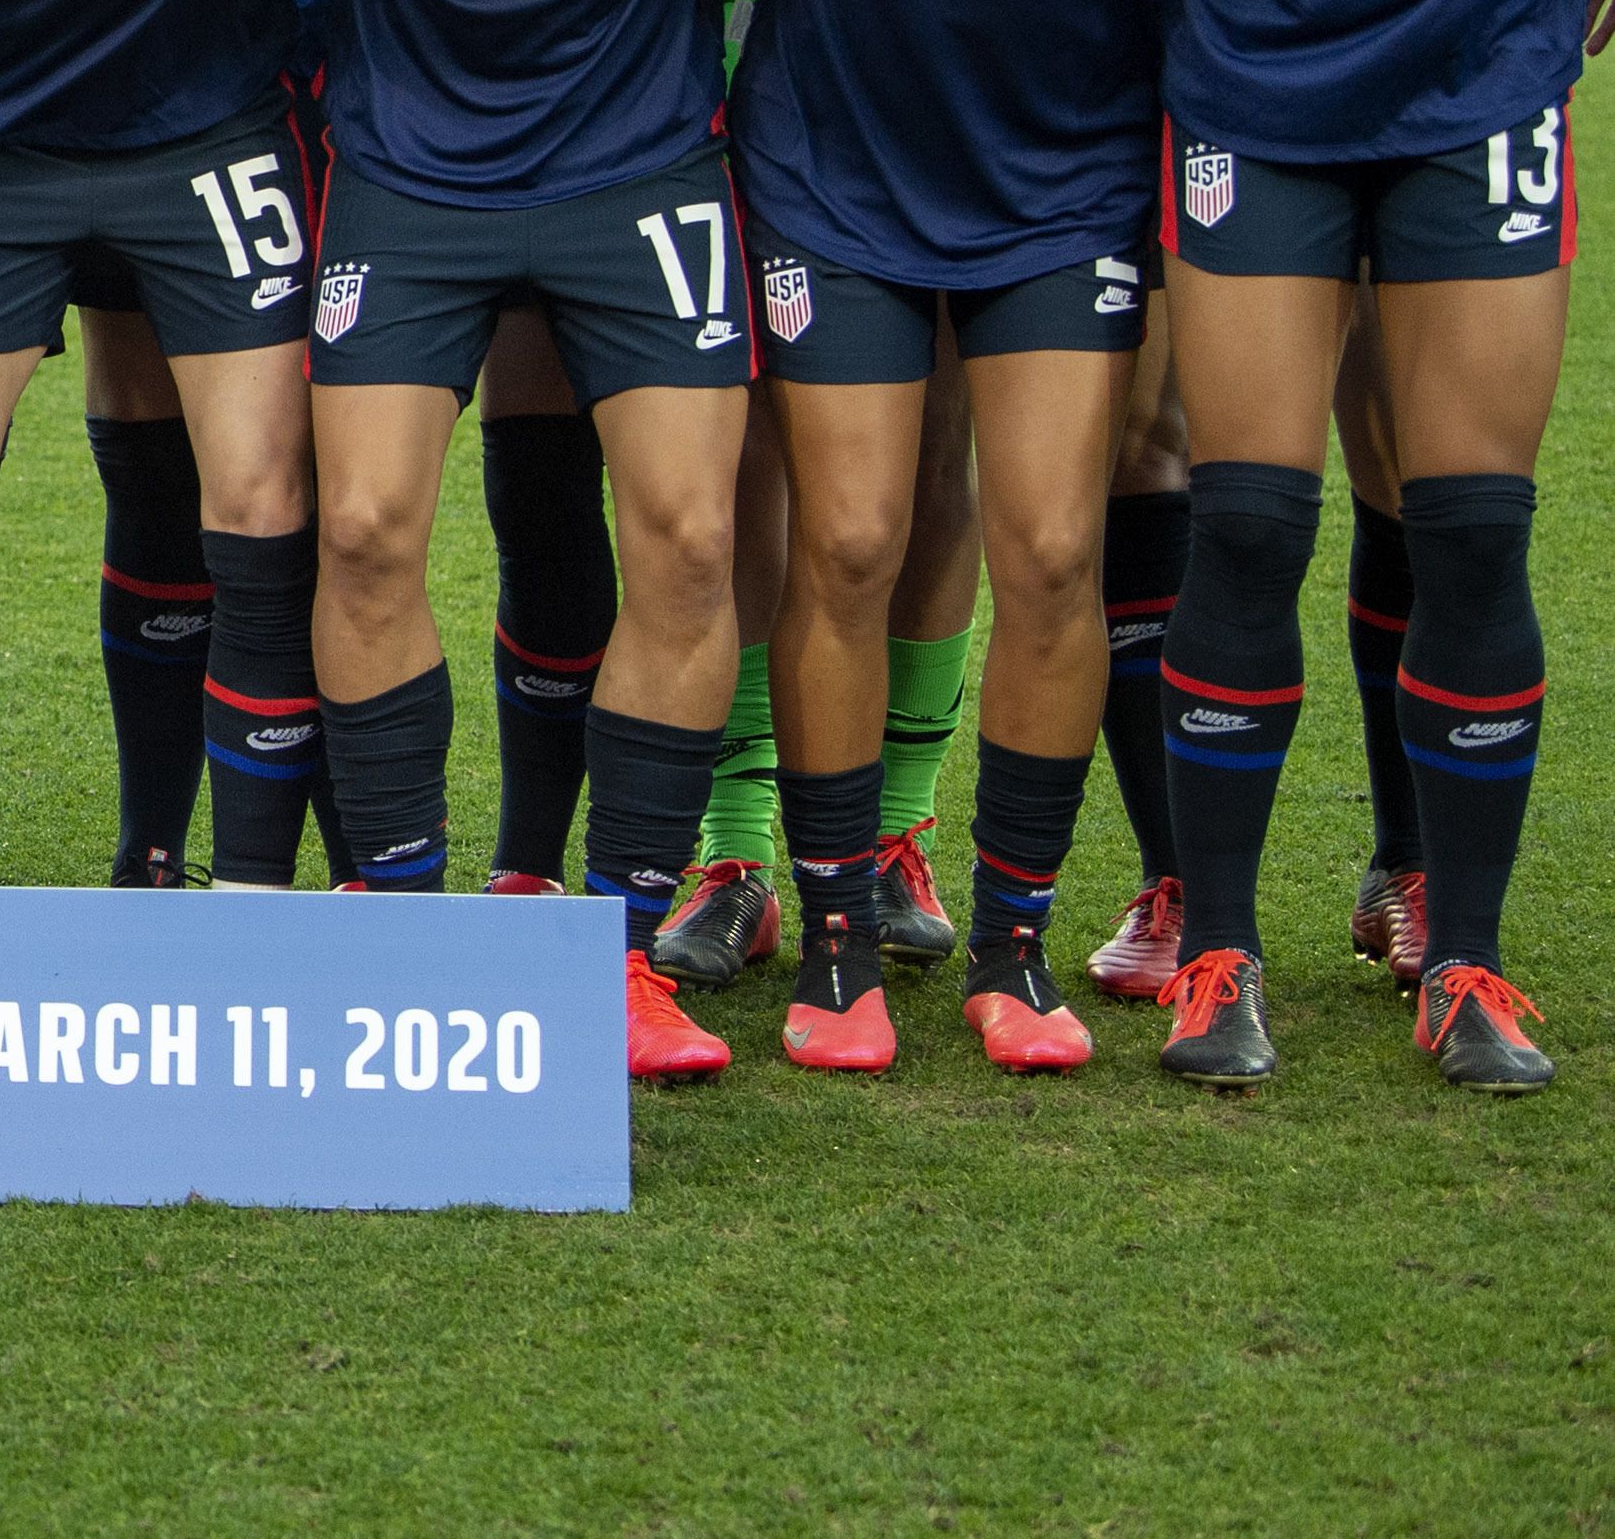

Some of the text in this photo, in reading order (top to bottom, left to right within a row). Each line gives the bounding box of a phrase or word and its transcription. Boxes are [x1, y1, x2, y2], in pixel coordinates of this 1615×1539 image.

[1487, 107, 1559, 205] 13
[1188, 159, 1228, 187] USA
[191, 153, 303, 278] 15
[1507, 211, 1541, 230] NIKE
[636, 202, 725, 319] 17
[258, 276, 293, 297] NIKE
[322, 278, 360, 306] USA
[767, 272, 805, 302] USA
[1102, 285, 1133, 305] NIKE
[703, 319, 733, 338] NIKE
[226, 1005, 316, 1099] 11,
[344, 1007, 542, 1095] 2020
